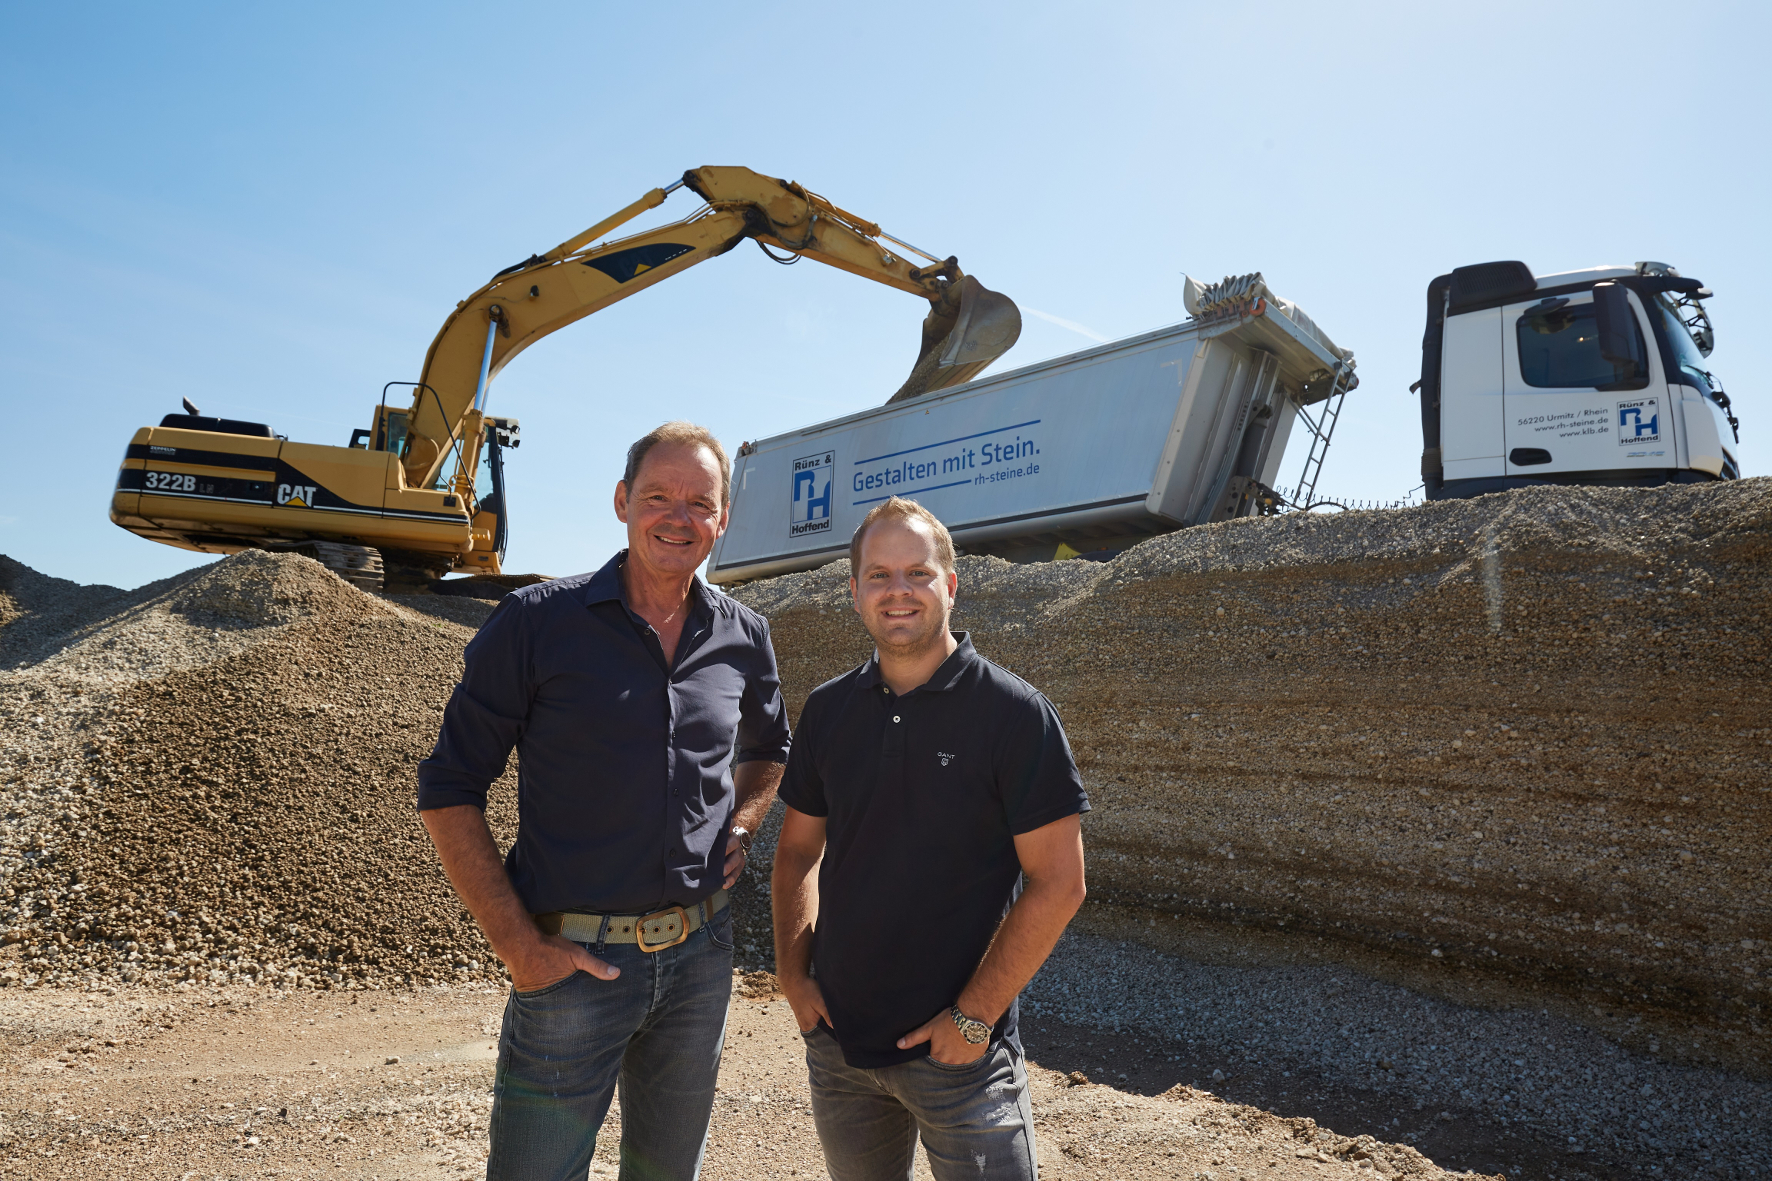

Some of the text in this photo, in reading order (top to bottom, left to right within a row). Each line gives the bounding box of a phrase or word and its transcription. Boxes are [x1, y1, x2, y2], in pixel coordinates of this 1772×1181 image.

[1518, 416, 1545, 426] 56220
[1547, 412, 1574, 422] Urmitz
[1584, 407, 1609, 417] Rhein
[1534, 417, 1609, 432] www.rh-steine.de
[1559, 426, 1609, 438] www.klb.de
[1621, 435, 1659, 444] Hoffend
[794, 454, 832, 471] Rünz &
[853, 435, 1040, 492] Gestalten mit Stein.
[145, 472, 196, 492] 322B
[974, 462, 1040, 486] rh-steine.de
[277, 483, 317, 507] CAT
[792, 519, 830, 535] Hoffend
